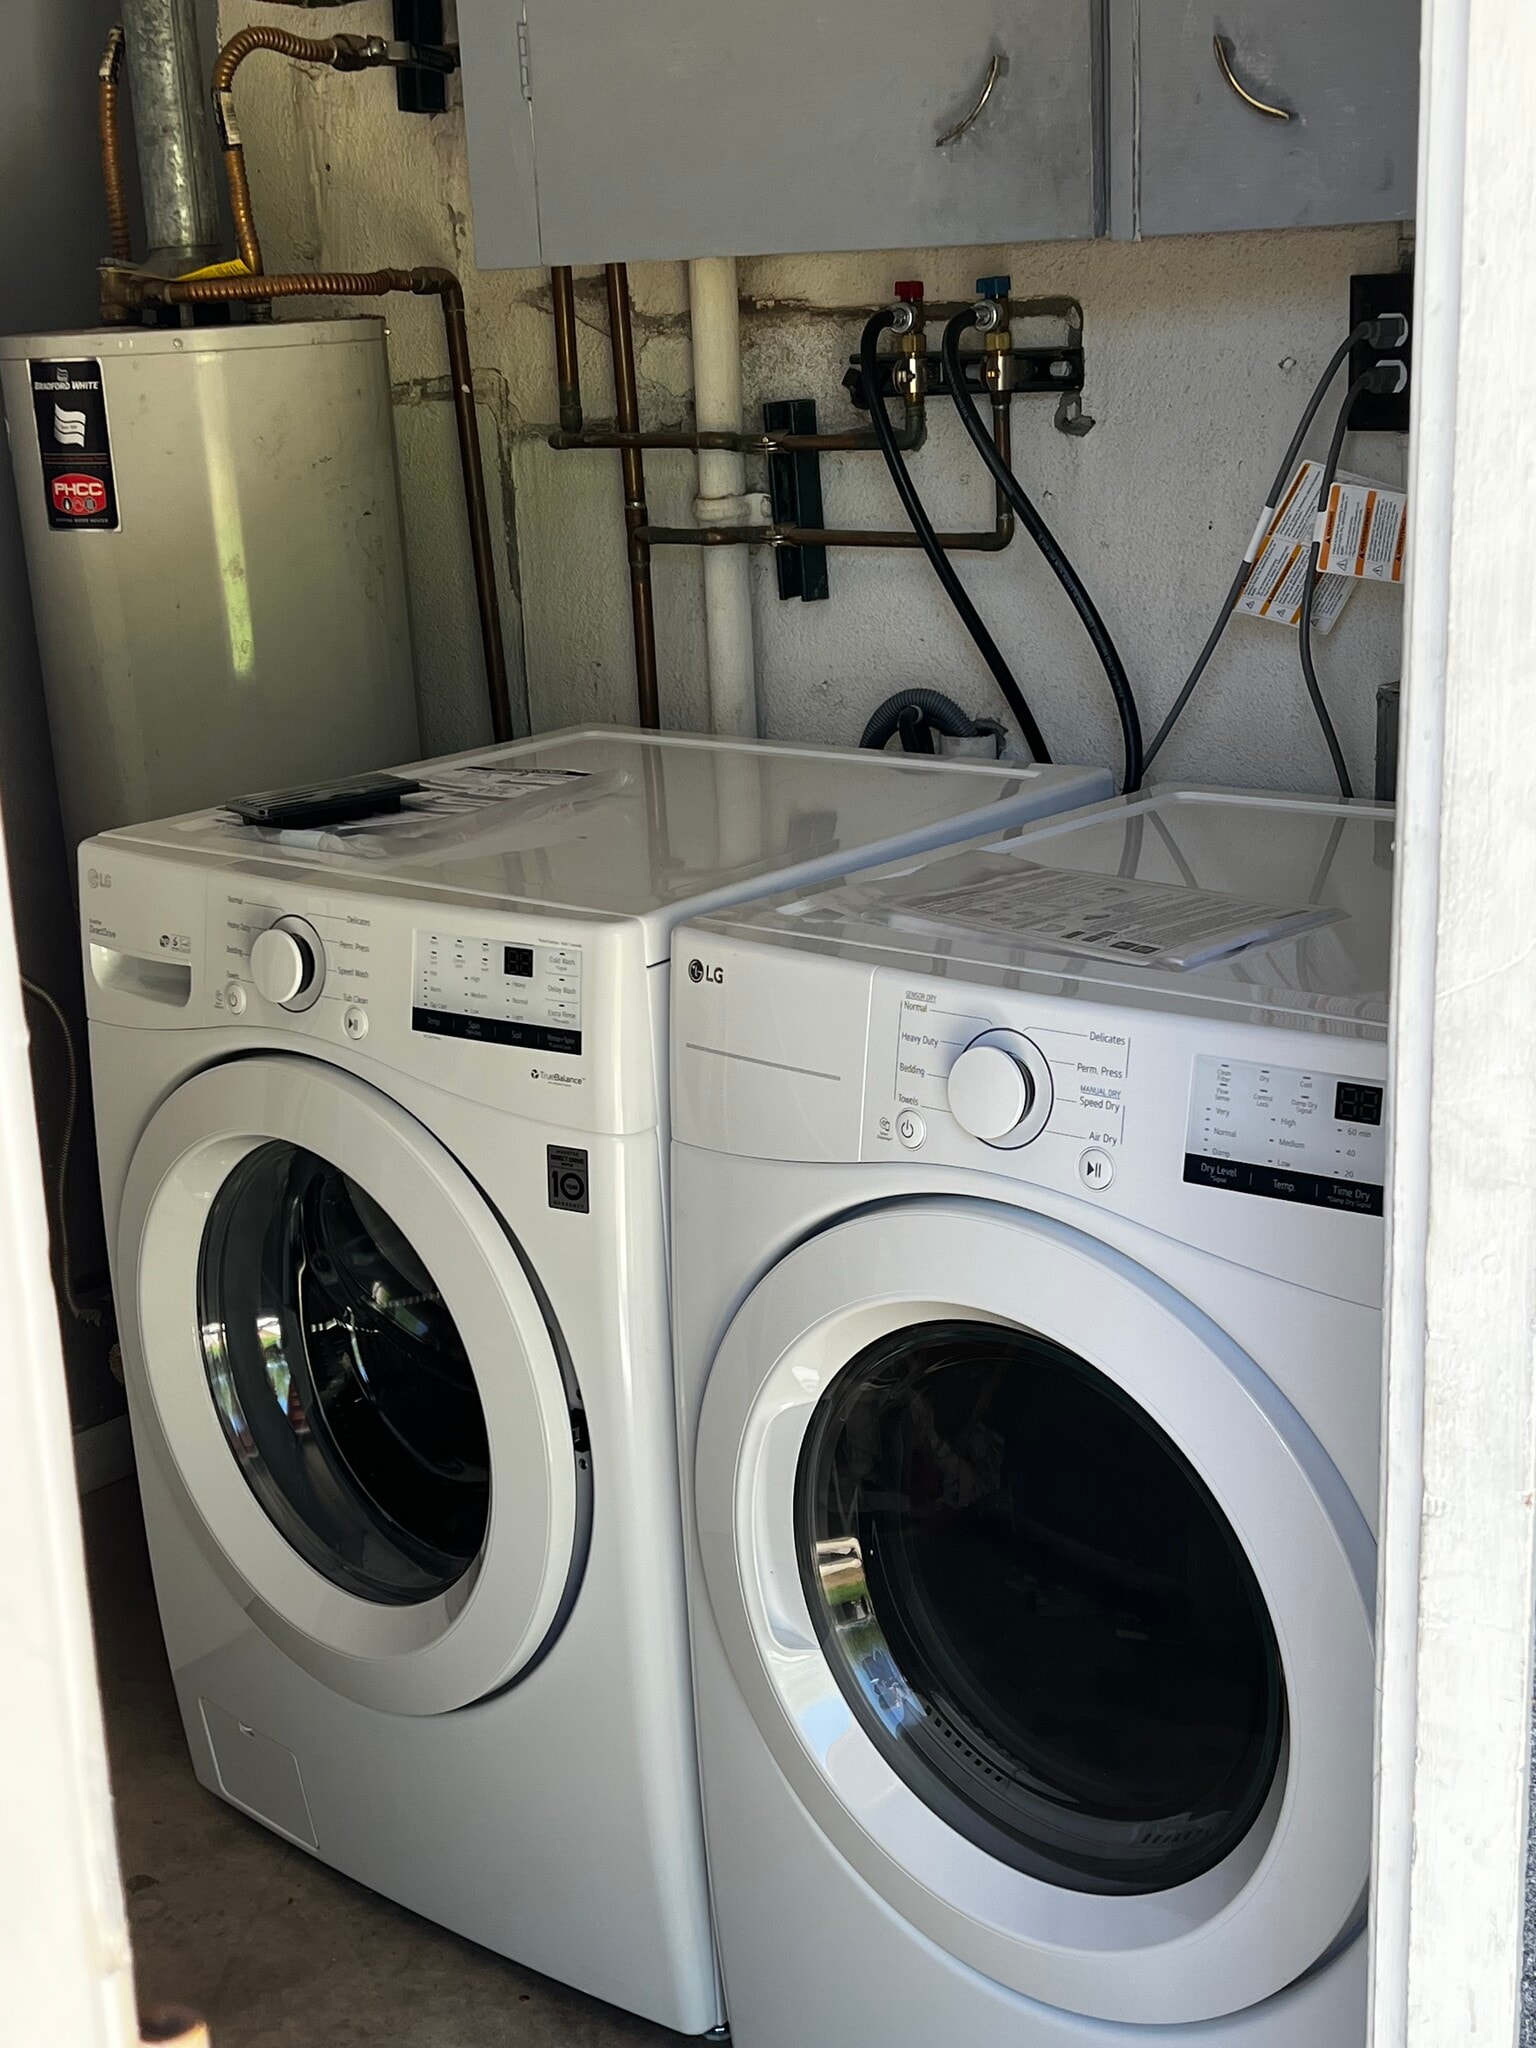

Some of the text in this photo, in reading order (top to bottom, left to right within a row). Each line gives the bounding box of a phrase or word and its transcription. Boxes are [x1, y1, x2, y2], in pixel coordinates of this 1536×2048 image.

[34, 380, 99, 390] BRADFORD WHITE
[54, 482, 103, 496] PHCC
[905, 990, 937, 1003] SENSOR DRY
[904, 1001, 928, 1012] Normal
[901, 1032, 939, 1048] Heavy Duty
[1089, 1031, 1126, 1046] Delicates
[899, 1062, 925, 1077] Bedding
[1077, 1062, 1123, 1079] Perm. Press
[1080, 1085, 1121, 1099] MANUAL DRY
[898, 1093, 919, 1106] Towels
[1080, 1096, 1120, 1114] Speed Dry
[1280, 1118, 1296, 1128] High
[1214, 1127, 1236, 1137] Normal
[1089, 1131, 1118, 1147] Air Dry
[1279, 1138, 1305, 1149] Medium
[1212, 1148, 1231, 1158] Damp
[1346, 1149, 1356, 1157] 40
[1200, 1162, 1237, 1177] Dry Level
[1277, 1160, 1290, 1168] Low
[1344, 1170, 1354, 1178] 20
[552, 1170, 585, 1201] 10
[1333, 1185, 1370, 1202] Time Dry
